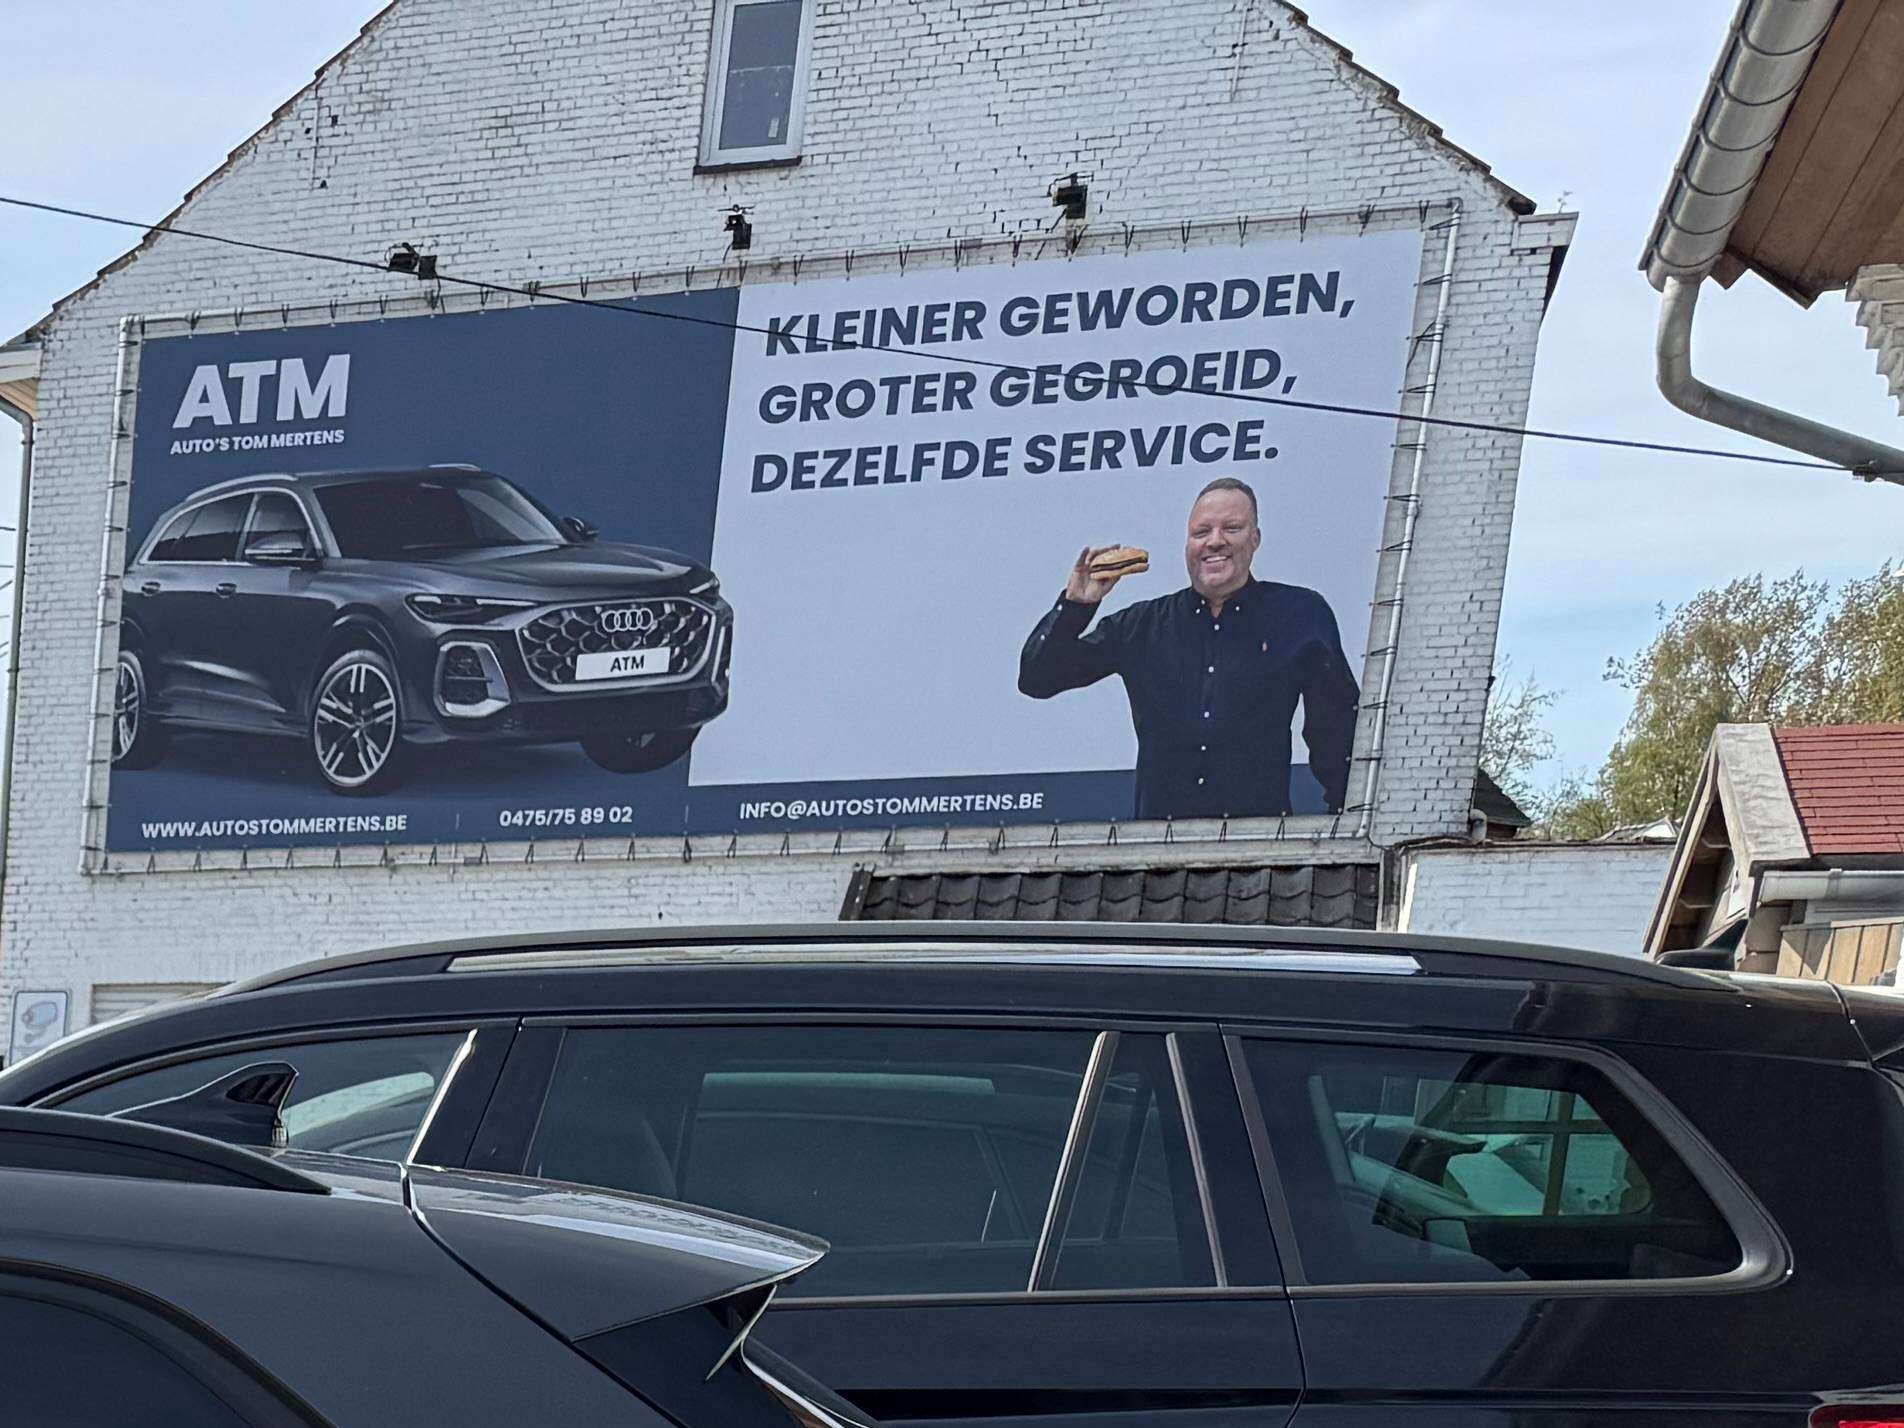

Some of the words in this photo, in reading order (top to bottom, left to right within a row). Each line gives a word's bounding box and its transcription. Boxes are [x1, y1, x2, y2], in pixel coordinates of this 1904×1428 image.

[765, 300, 984, 356] KLEINER
[999, 270, 1355, 335] GEWORDEN,
[172, 354, 350, 428] ATM
[758, 371, 977, 424] GROTER
[989, 347, 1298, 406] GEGROEID,
[170, 436, 229, 454] AUTO'S
[232, 434, 268, 449] TOM
[270, 429, 345, 448] MERTENS
[751, 436, 1010, 493] DEZELFDE
[1023, 419, 1280, 475] SERVICE.
[610, 655, 645, 672] ATM
[499, 807, 576, 827] 0475/75
[580, 807, 605, 825] 89
[608, 806, 633, 824] 02
[739, 792, 1044, 820] INFO@AUTOSTOMMERTENS.BE
[142, 814, 407, 838] WWW.AUTOSTOMMERTENS.BE
